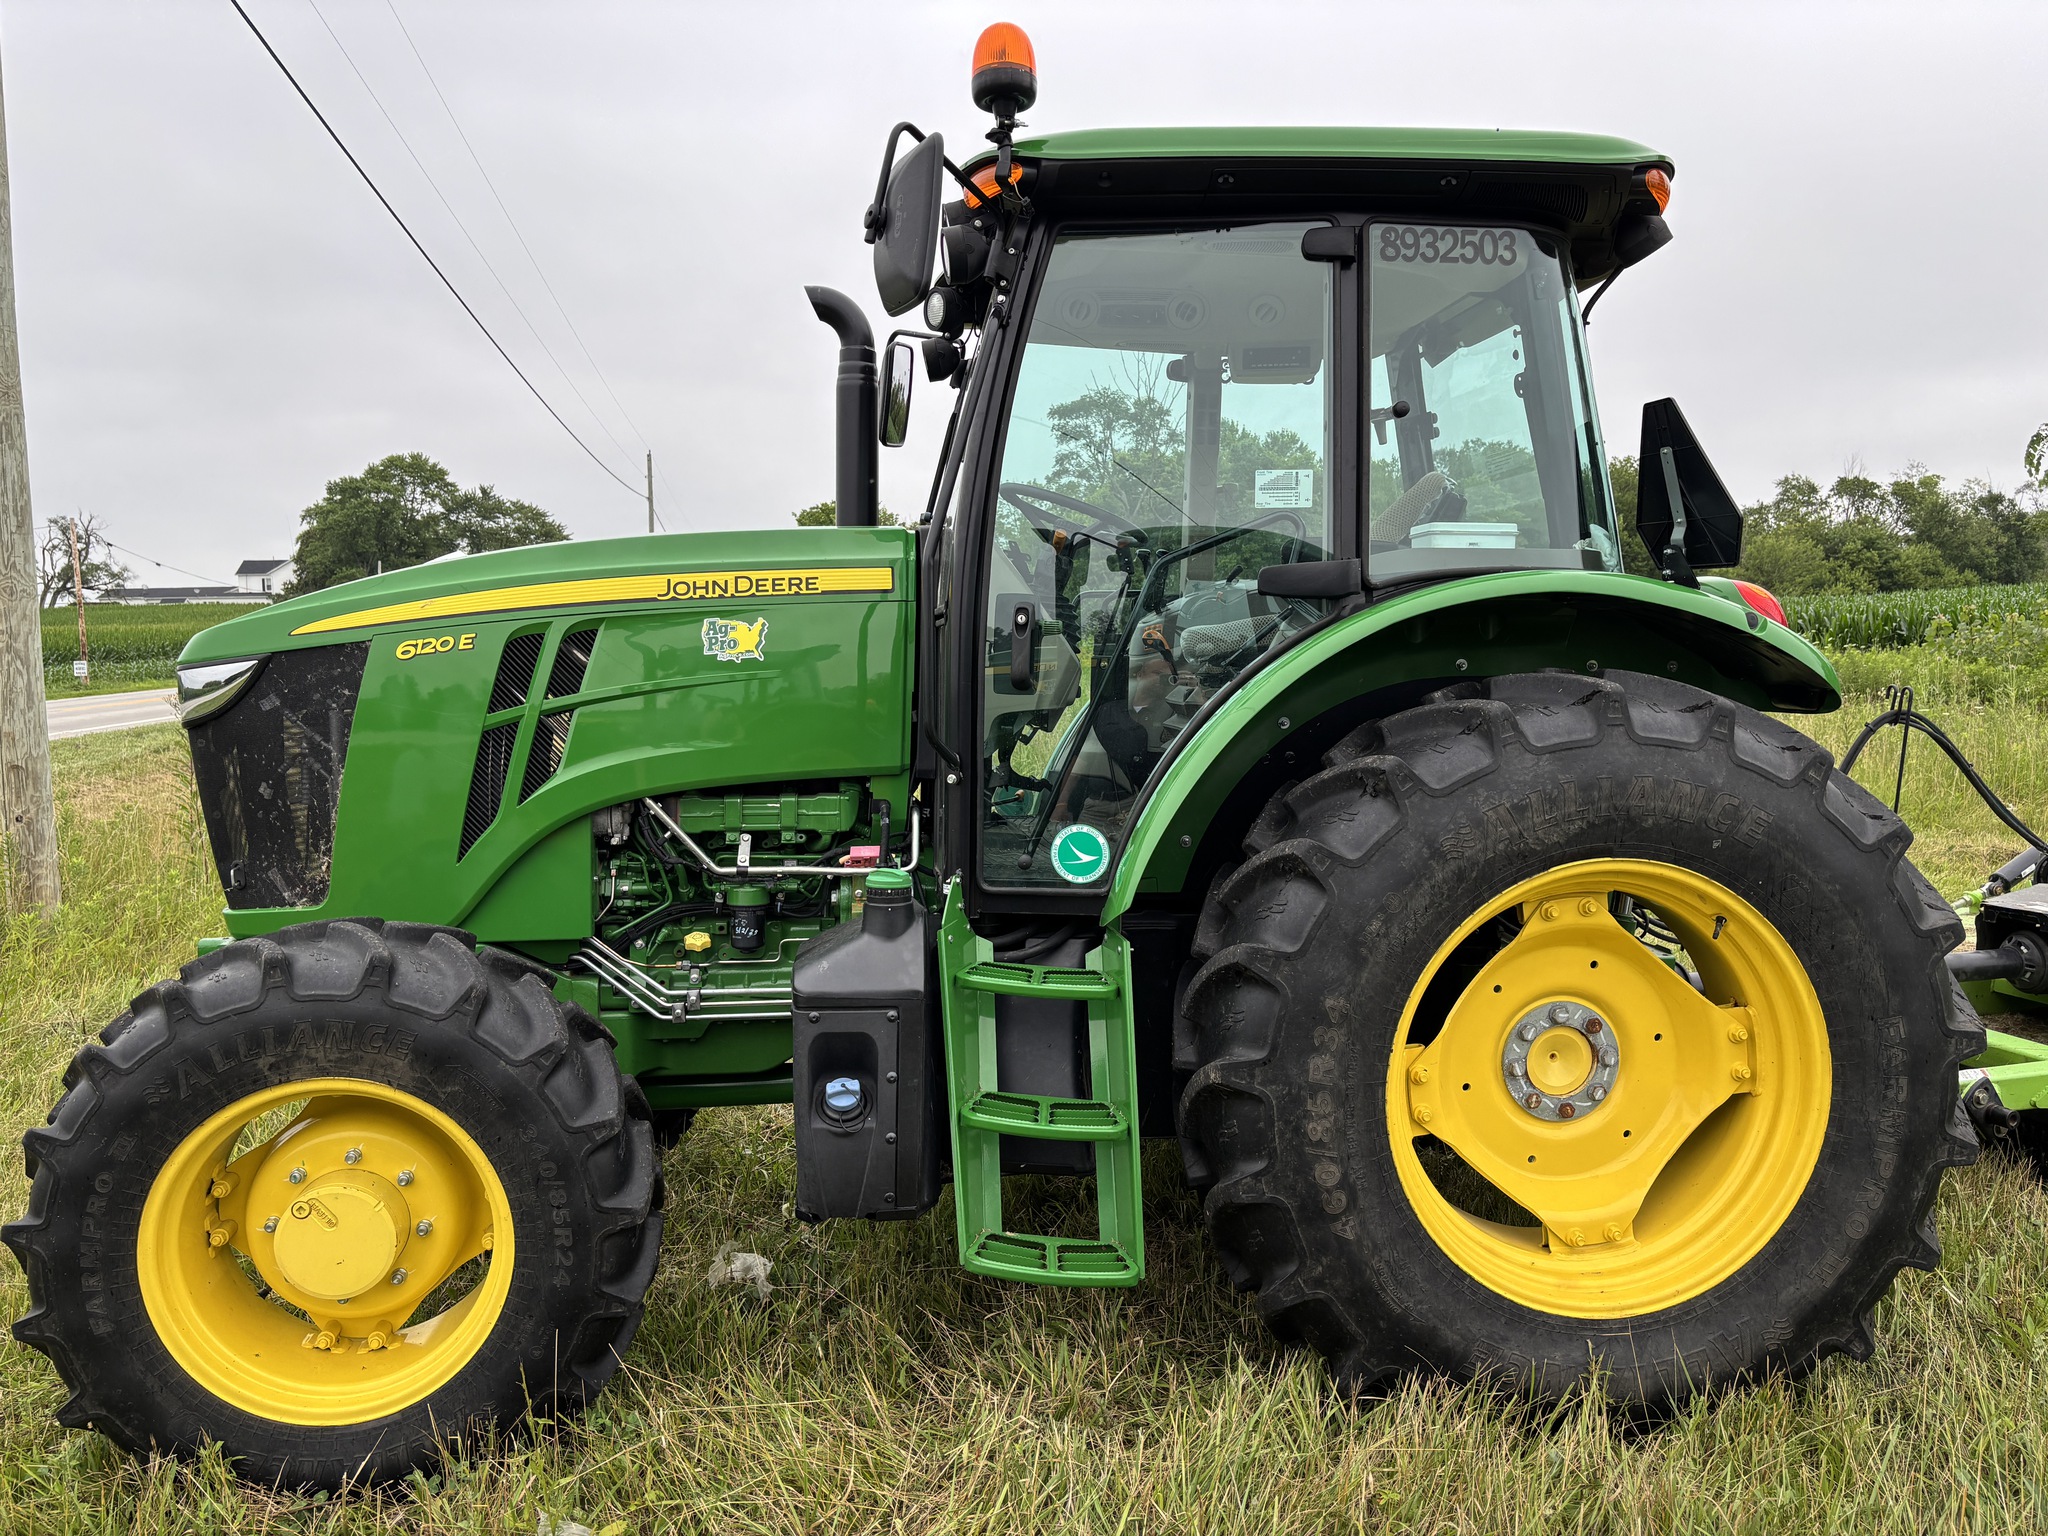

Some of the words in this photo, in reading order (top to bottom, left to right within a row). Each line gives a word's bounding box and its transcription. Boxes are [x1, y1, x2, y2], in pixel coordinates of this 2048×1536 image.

[1380, 226, 1517, 266] 8932503
[657, 578, 728, 597] JOHN
[734, 575, 819, 594] DEERE
[395, 636, 455, 660] 6120
[458, 633, 477, 651] E
[707, 636, 738, 652] Pro
[1059, 828, 1074, 840] STATE
[1086, 828, 1100, 839] OHIO
[1481, 775, 1776, 861] ALLIANCE
[1053, 844, 1070, 878] DEPARTMENT
[1082, 842, 1108, 882] TRANSPORTATION
[173, 1018, 418, 1099] ALLIANCE
[1308, 996, 1357, 1240] 460/85R34
[1845, 1015, 1908, 1240] FARMPRO
[519, 1124, 574, 1288] 340/85R24
[79, 1172, 116, 1336] FARMPRO
